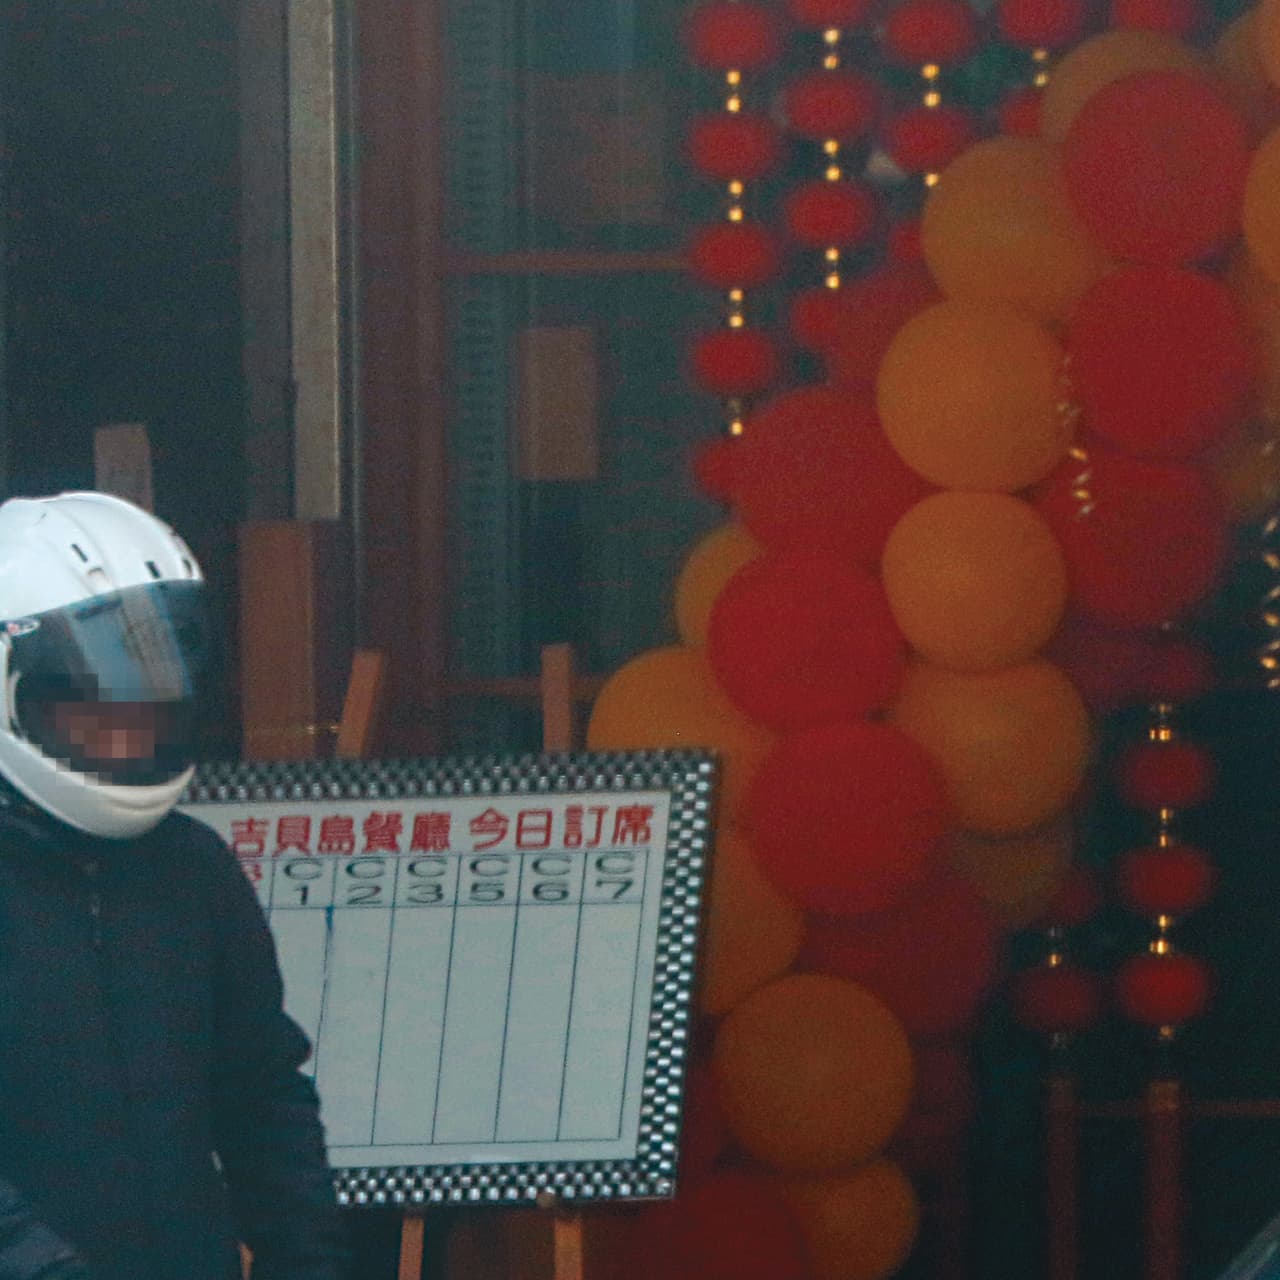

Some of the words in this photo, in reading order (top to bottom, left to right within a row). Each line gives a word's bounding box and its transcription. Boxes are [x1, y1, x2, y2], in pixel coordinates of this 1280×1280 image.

[230, 810, 453, 858] 吉貝島餐廳
[468, 803, 655, 852] 今日訂席
